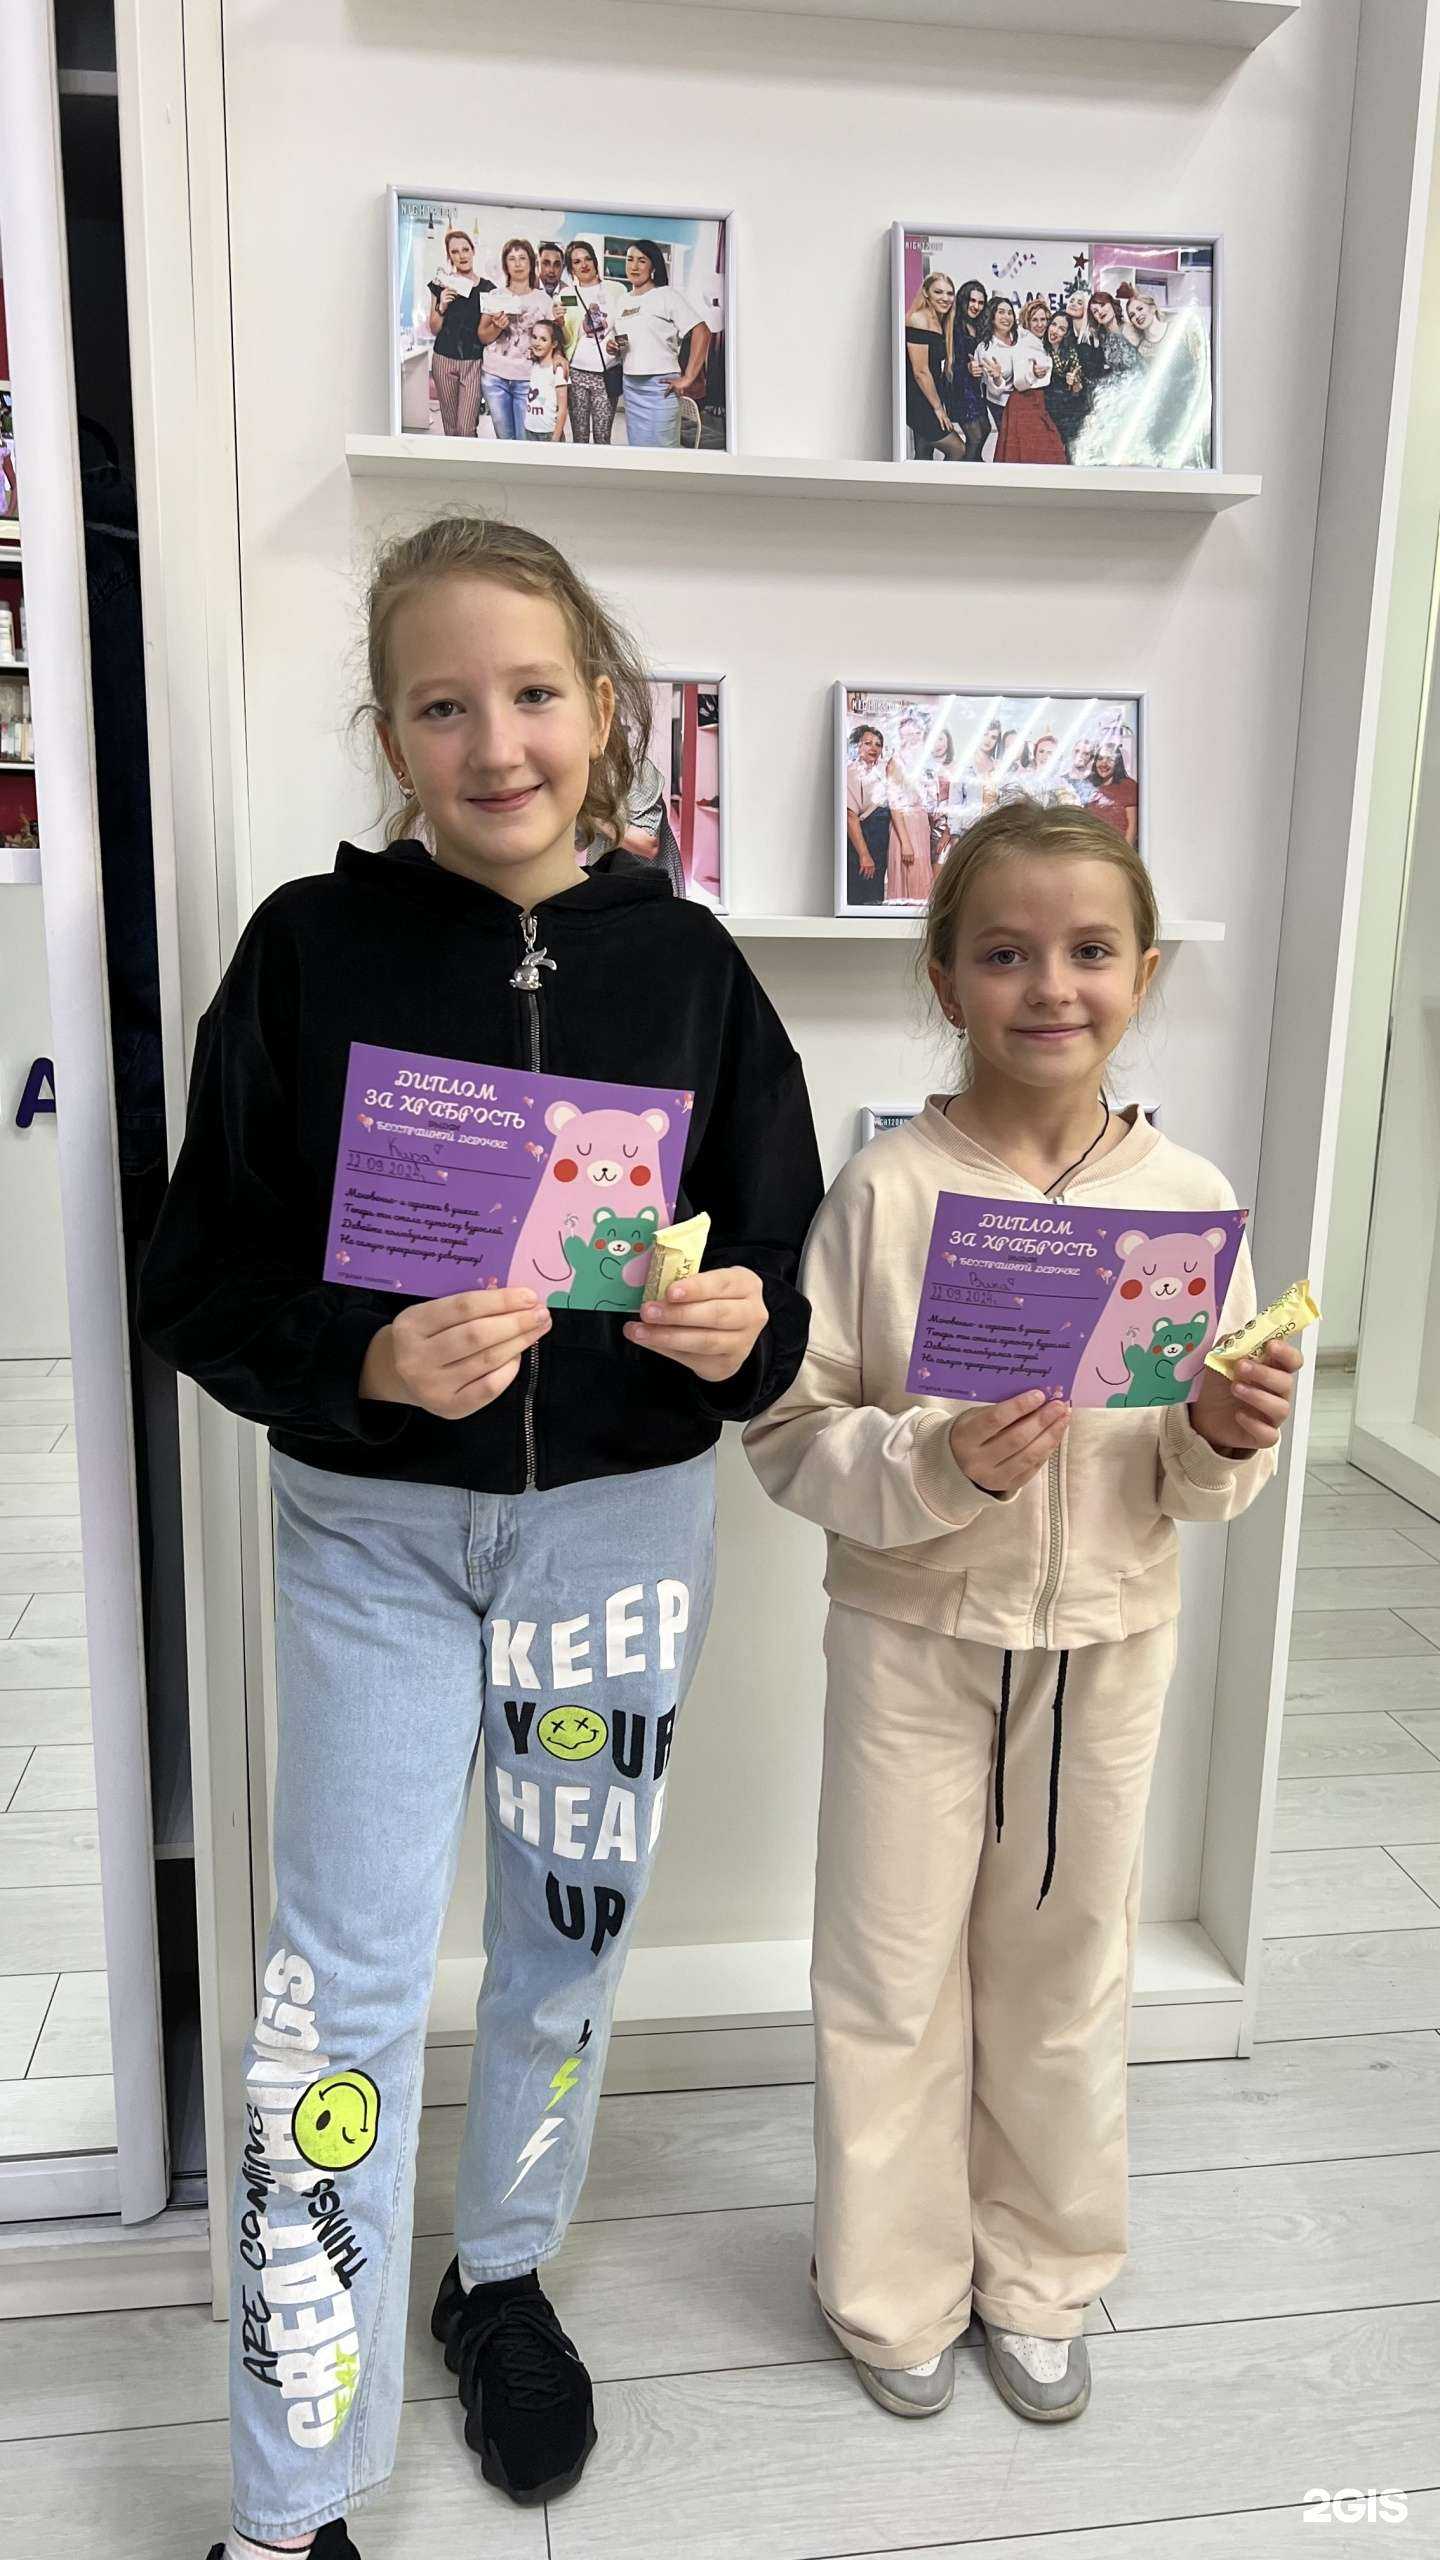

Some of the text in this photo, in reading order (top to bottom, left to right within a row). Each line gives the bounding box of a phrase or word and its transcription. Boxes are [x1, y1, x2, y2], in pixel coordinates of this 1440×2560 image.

[394, 1070, 498, 1101] ДИПЛОМ
[364, 1089, 394, 1109] ЗА
[400, 1095, 526, 1129] ХРАБРОСТЬ
[340, 1233, 354, 1245] На
[949, 1230, 1098, 1258] ЗА ХРАБРОСТЬ
[978, 1213, 1074, 1235] ДИПЛОМ
[491, 1578, 690, 1690] KEEP
[545, 1870, 626, 1957] UP
[301, 2178, 367, 2290] THINGS
[243, 2285, 283, 2387] ARE
